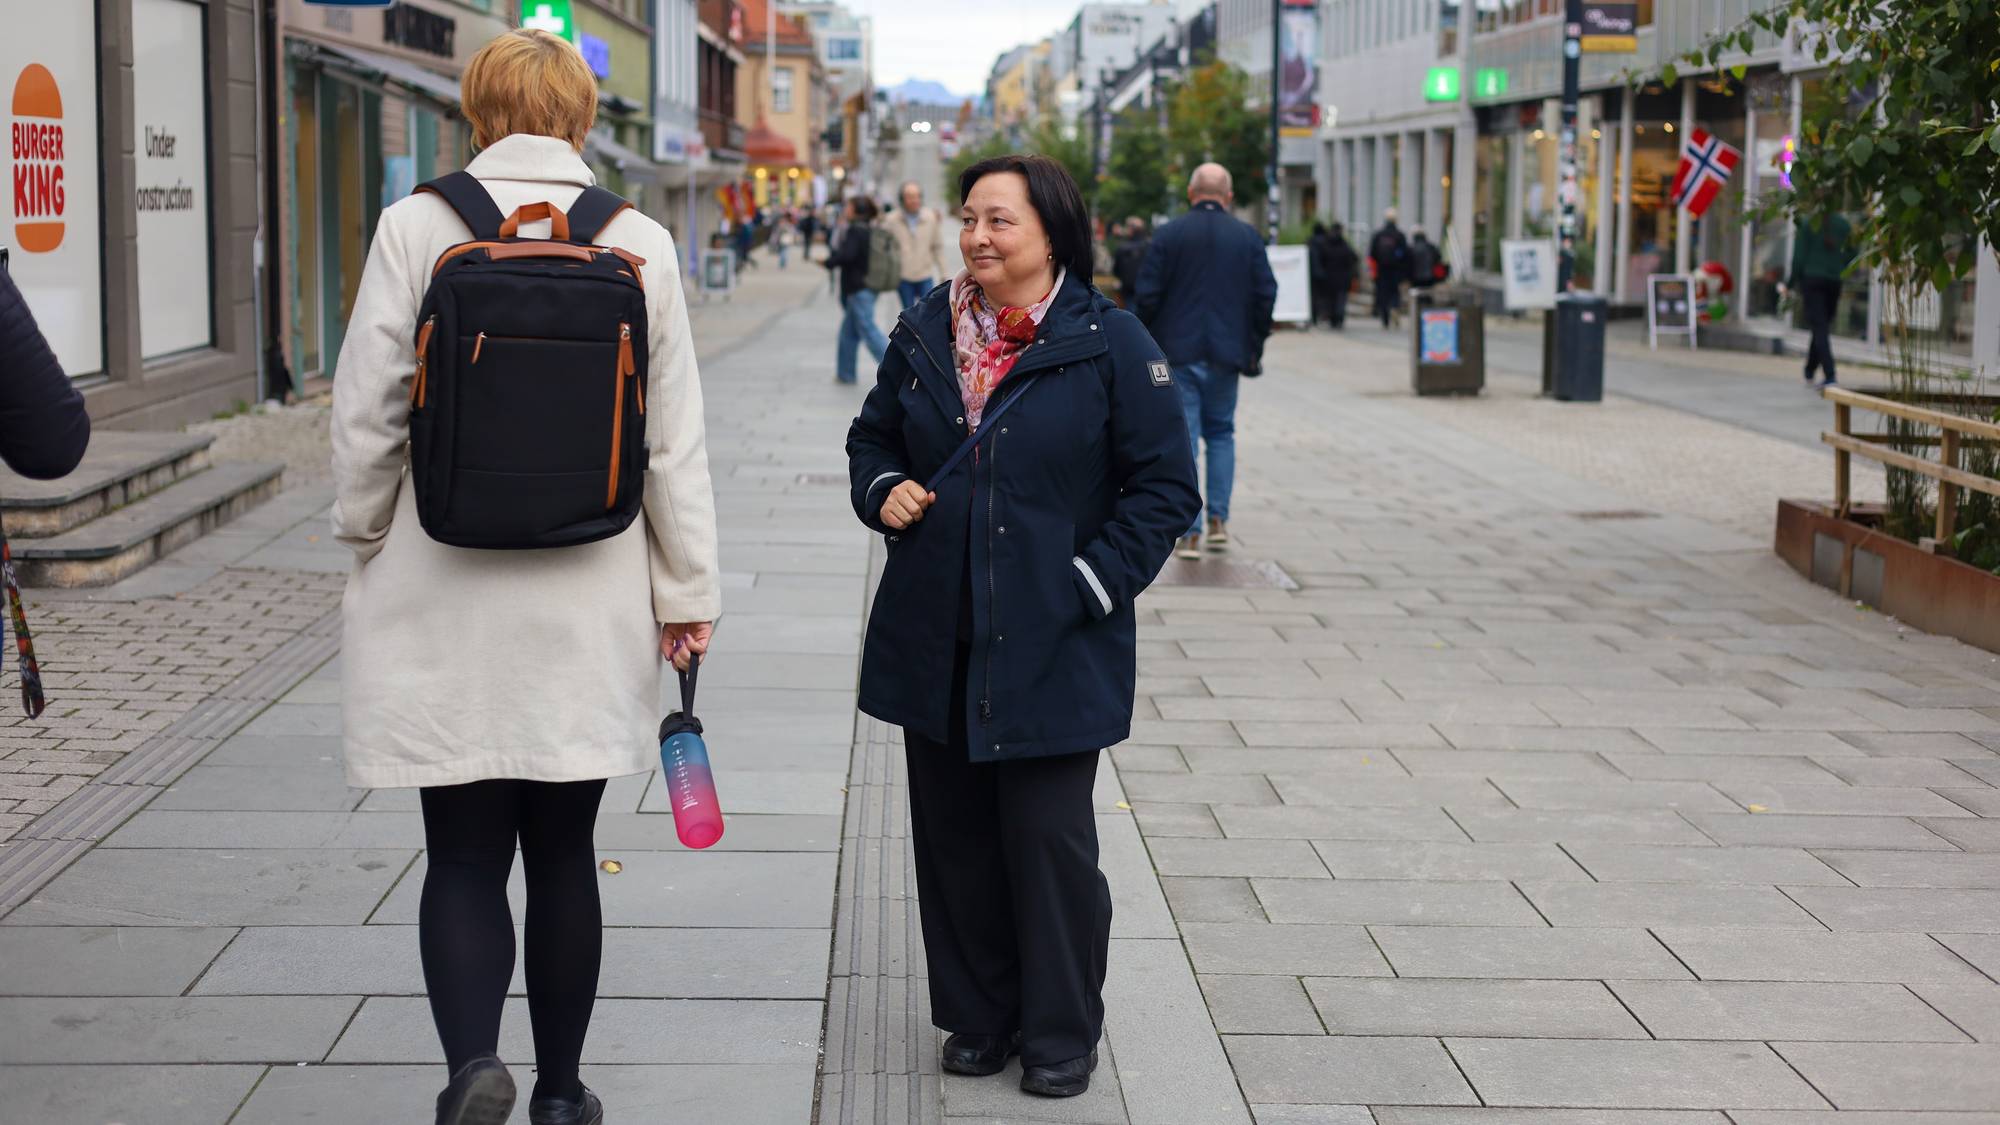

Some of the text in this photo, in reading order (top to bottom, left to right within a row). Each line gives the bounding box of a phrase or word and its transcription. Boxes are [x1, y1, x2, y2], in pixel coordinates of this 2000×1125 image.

[12, 122, 64, 160] BURGER
[145, 125, 176, 158] Under
[13, 163, 65, 218] KING
[136, 177, 193, 211] onstruction
